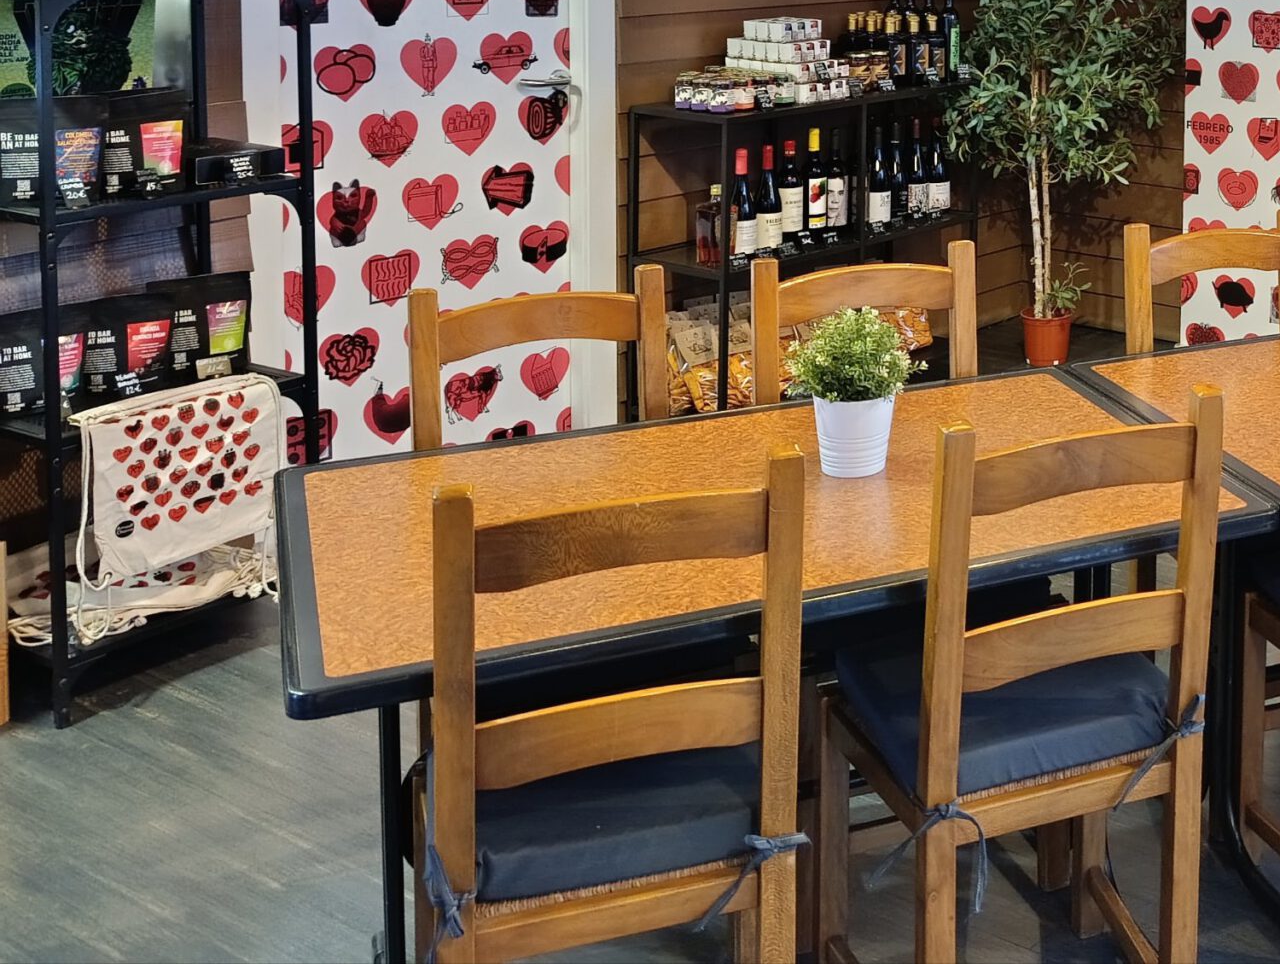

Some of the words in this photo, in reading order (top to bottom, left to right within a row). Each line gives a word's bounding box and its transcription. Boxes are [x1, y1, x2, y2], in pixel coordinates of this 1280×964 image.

[1186, 120, 1234, 134] FEBRERO
[111, 135, 131, 144] HOME
[1198, 134, 1221, 145] 1985
[179, 315, 197, 323] HOME
[97, 336, 116, 344] HOME
[13, 346, 28, 354] BAR
[13, 352, 32, 361] HOME
